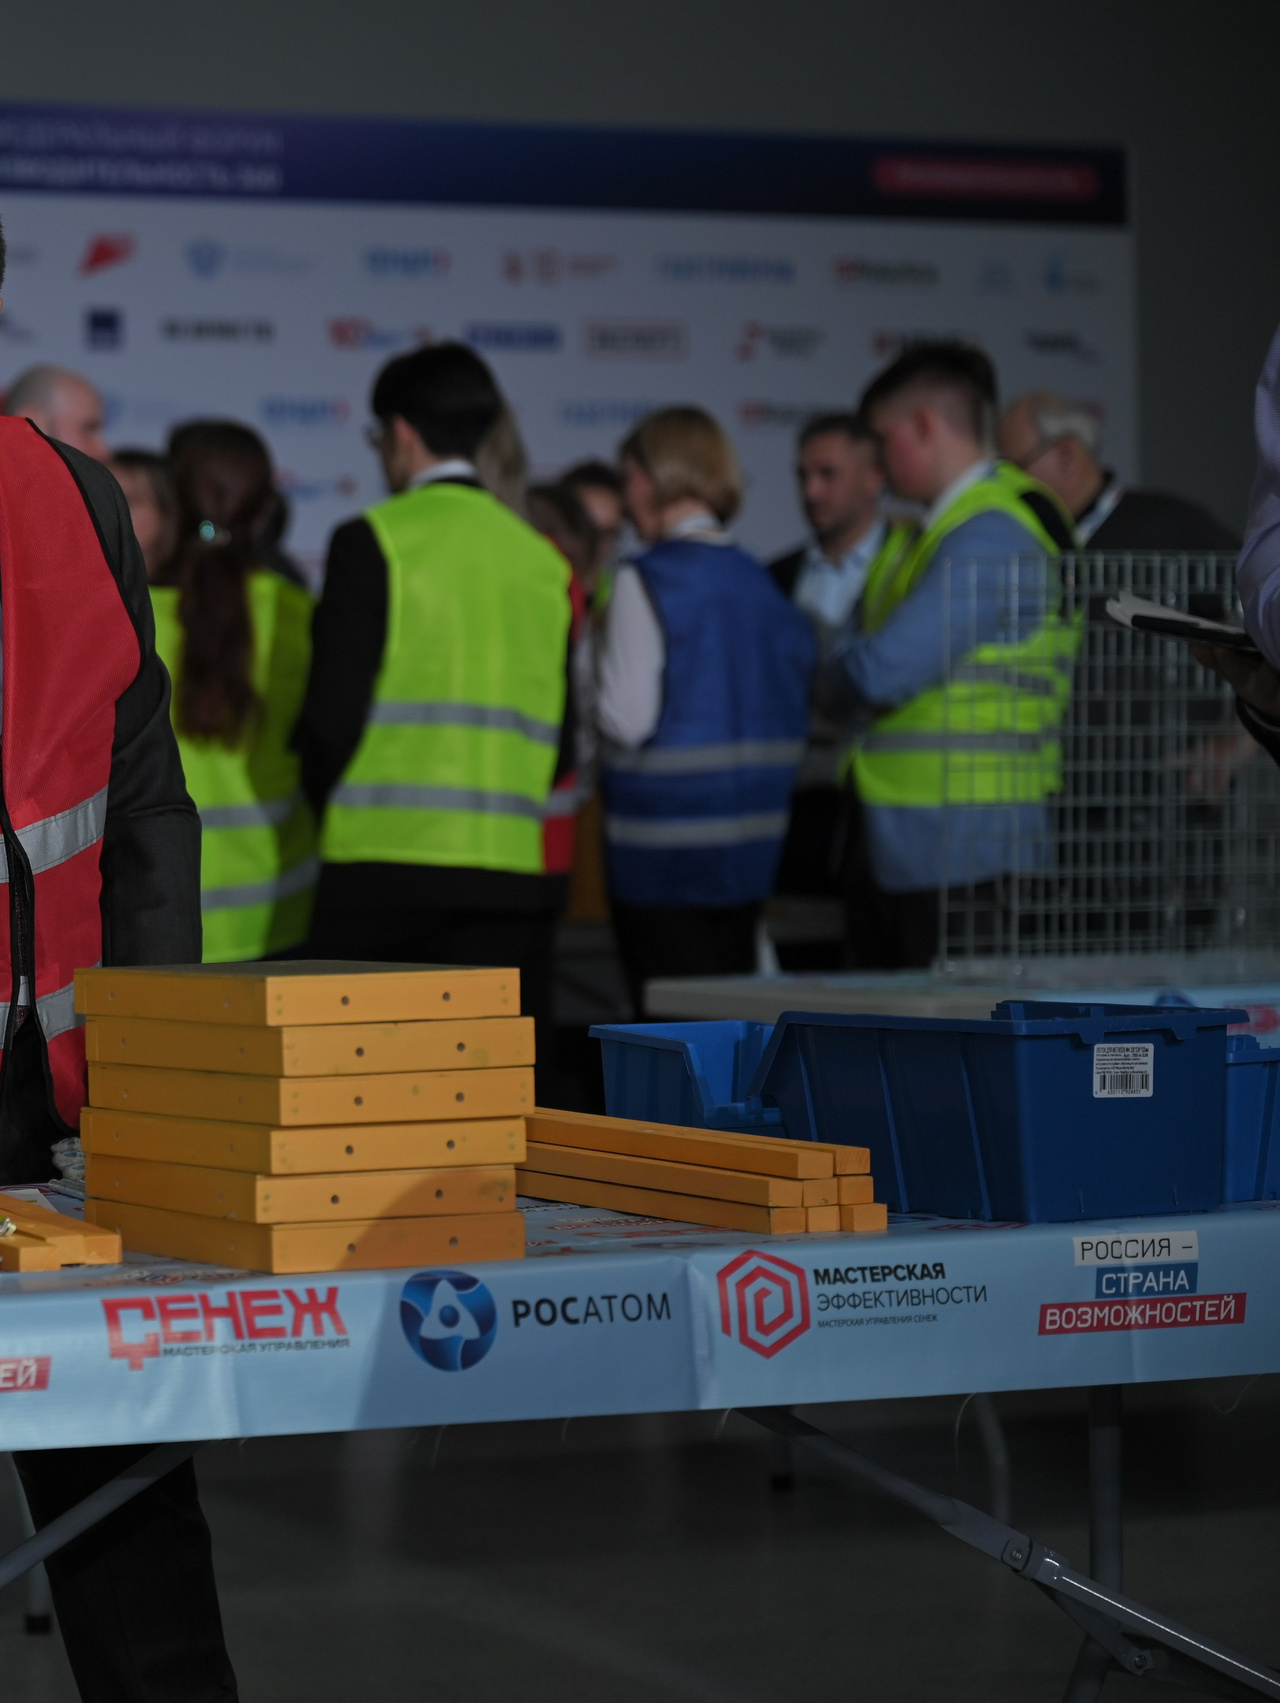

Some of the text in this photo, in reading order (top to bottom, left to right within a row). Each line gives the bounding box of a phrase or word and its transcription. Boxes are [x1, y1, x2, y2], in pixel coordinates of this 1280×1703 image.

[1081, 1238, 1171, 1261] РОССИЯ
[813, 1262, 946, 1286] МАСТЕРСКАЯ
[1101, 1269, 1190, 1295] СТРАНА
[512, 1292, 672, 1327] РОСАТОМ
[816, 1285, 987, 1312] ЭФФЕКТИВНОСТИ
[816, 1314, 938, 1329] МАСТЕРСКАЯ УПРАВЛЕНИЯ СЕНЕЖ
[1045, 1295, 1236, 1331] ВОЗМОЖНОСТЕЙ
[101, 1287, 348, 1371] СЕНЕЖ
[162, 1338, 351, 1357] МАСТЕРСКАЯ УПРАВЛЕНИЯ
